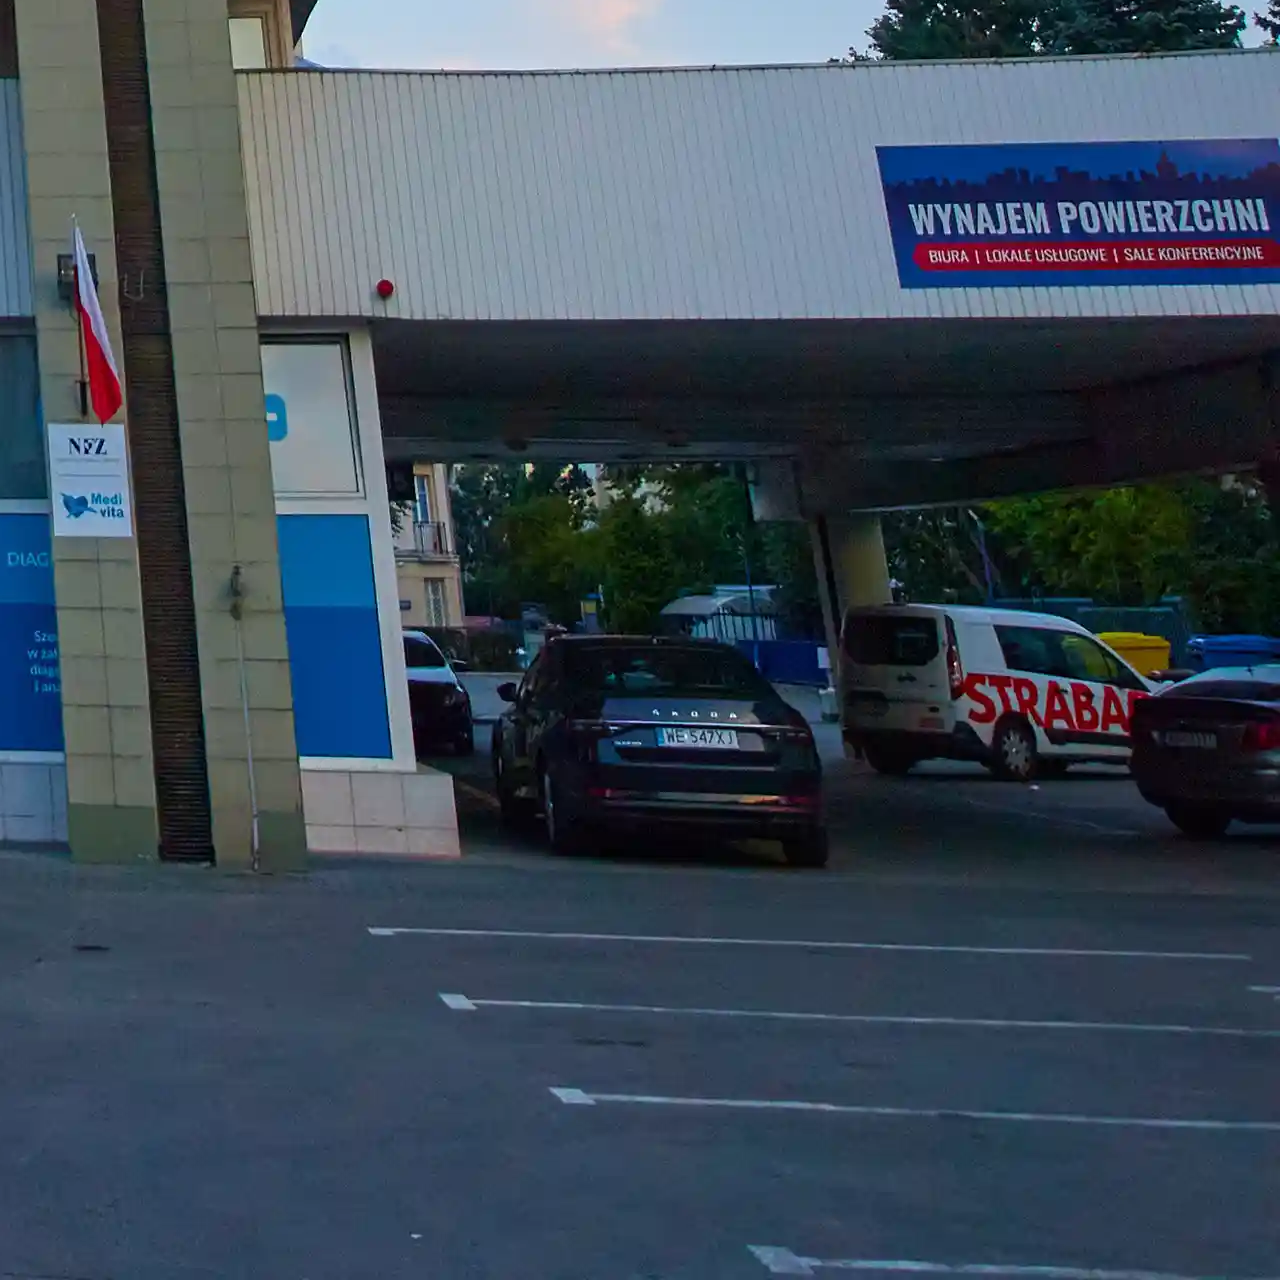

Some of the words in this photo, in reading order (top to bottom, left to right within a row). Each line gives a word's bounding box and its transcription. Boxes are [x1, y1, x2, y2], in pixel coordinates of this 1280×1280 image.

[907, 202, 1051, 236] WYNAJEM
[1056, 198, 1270, 234] POWIERZCHNI
[928, 249, 969, 264] BIURA
[986, 248, 1033, 263] LOKALE
[1035, 247, 1108, 263] USŁUGOWE
[1123, 247, 1157, 262] SALE
[1158, 246, 1264, 262] KONFERENCYJNE
[68, 437, 108, 455] NFZ
[90, 492, 122, 505] Medi
[100, 506, 125, 518] vita
[665, 729, 685, 741] WE
